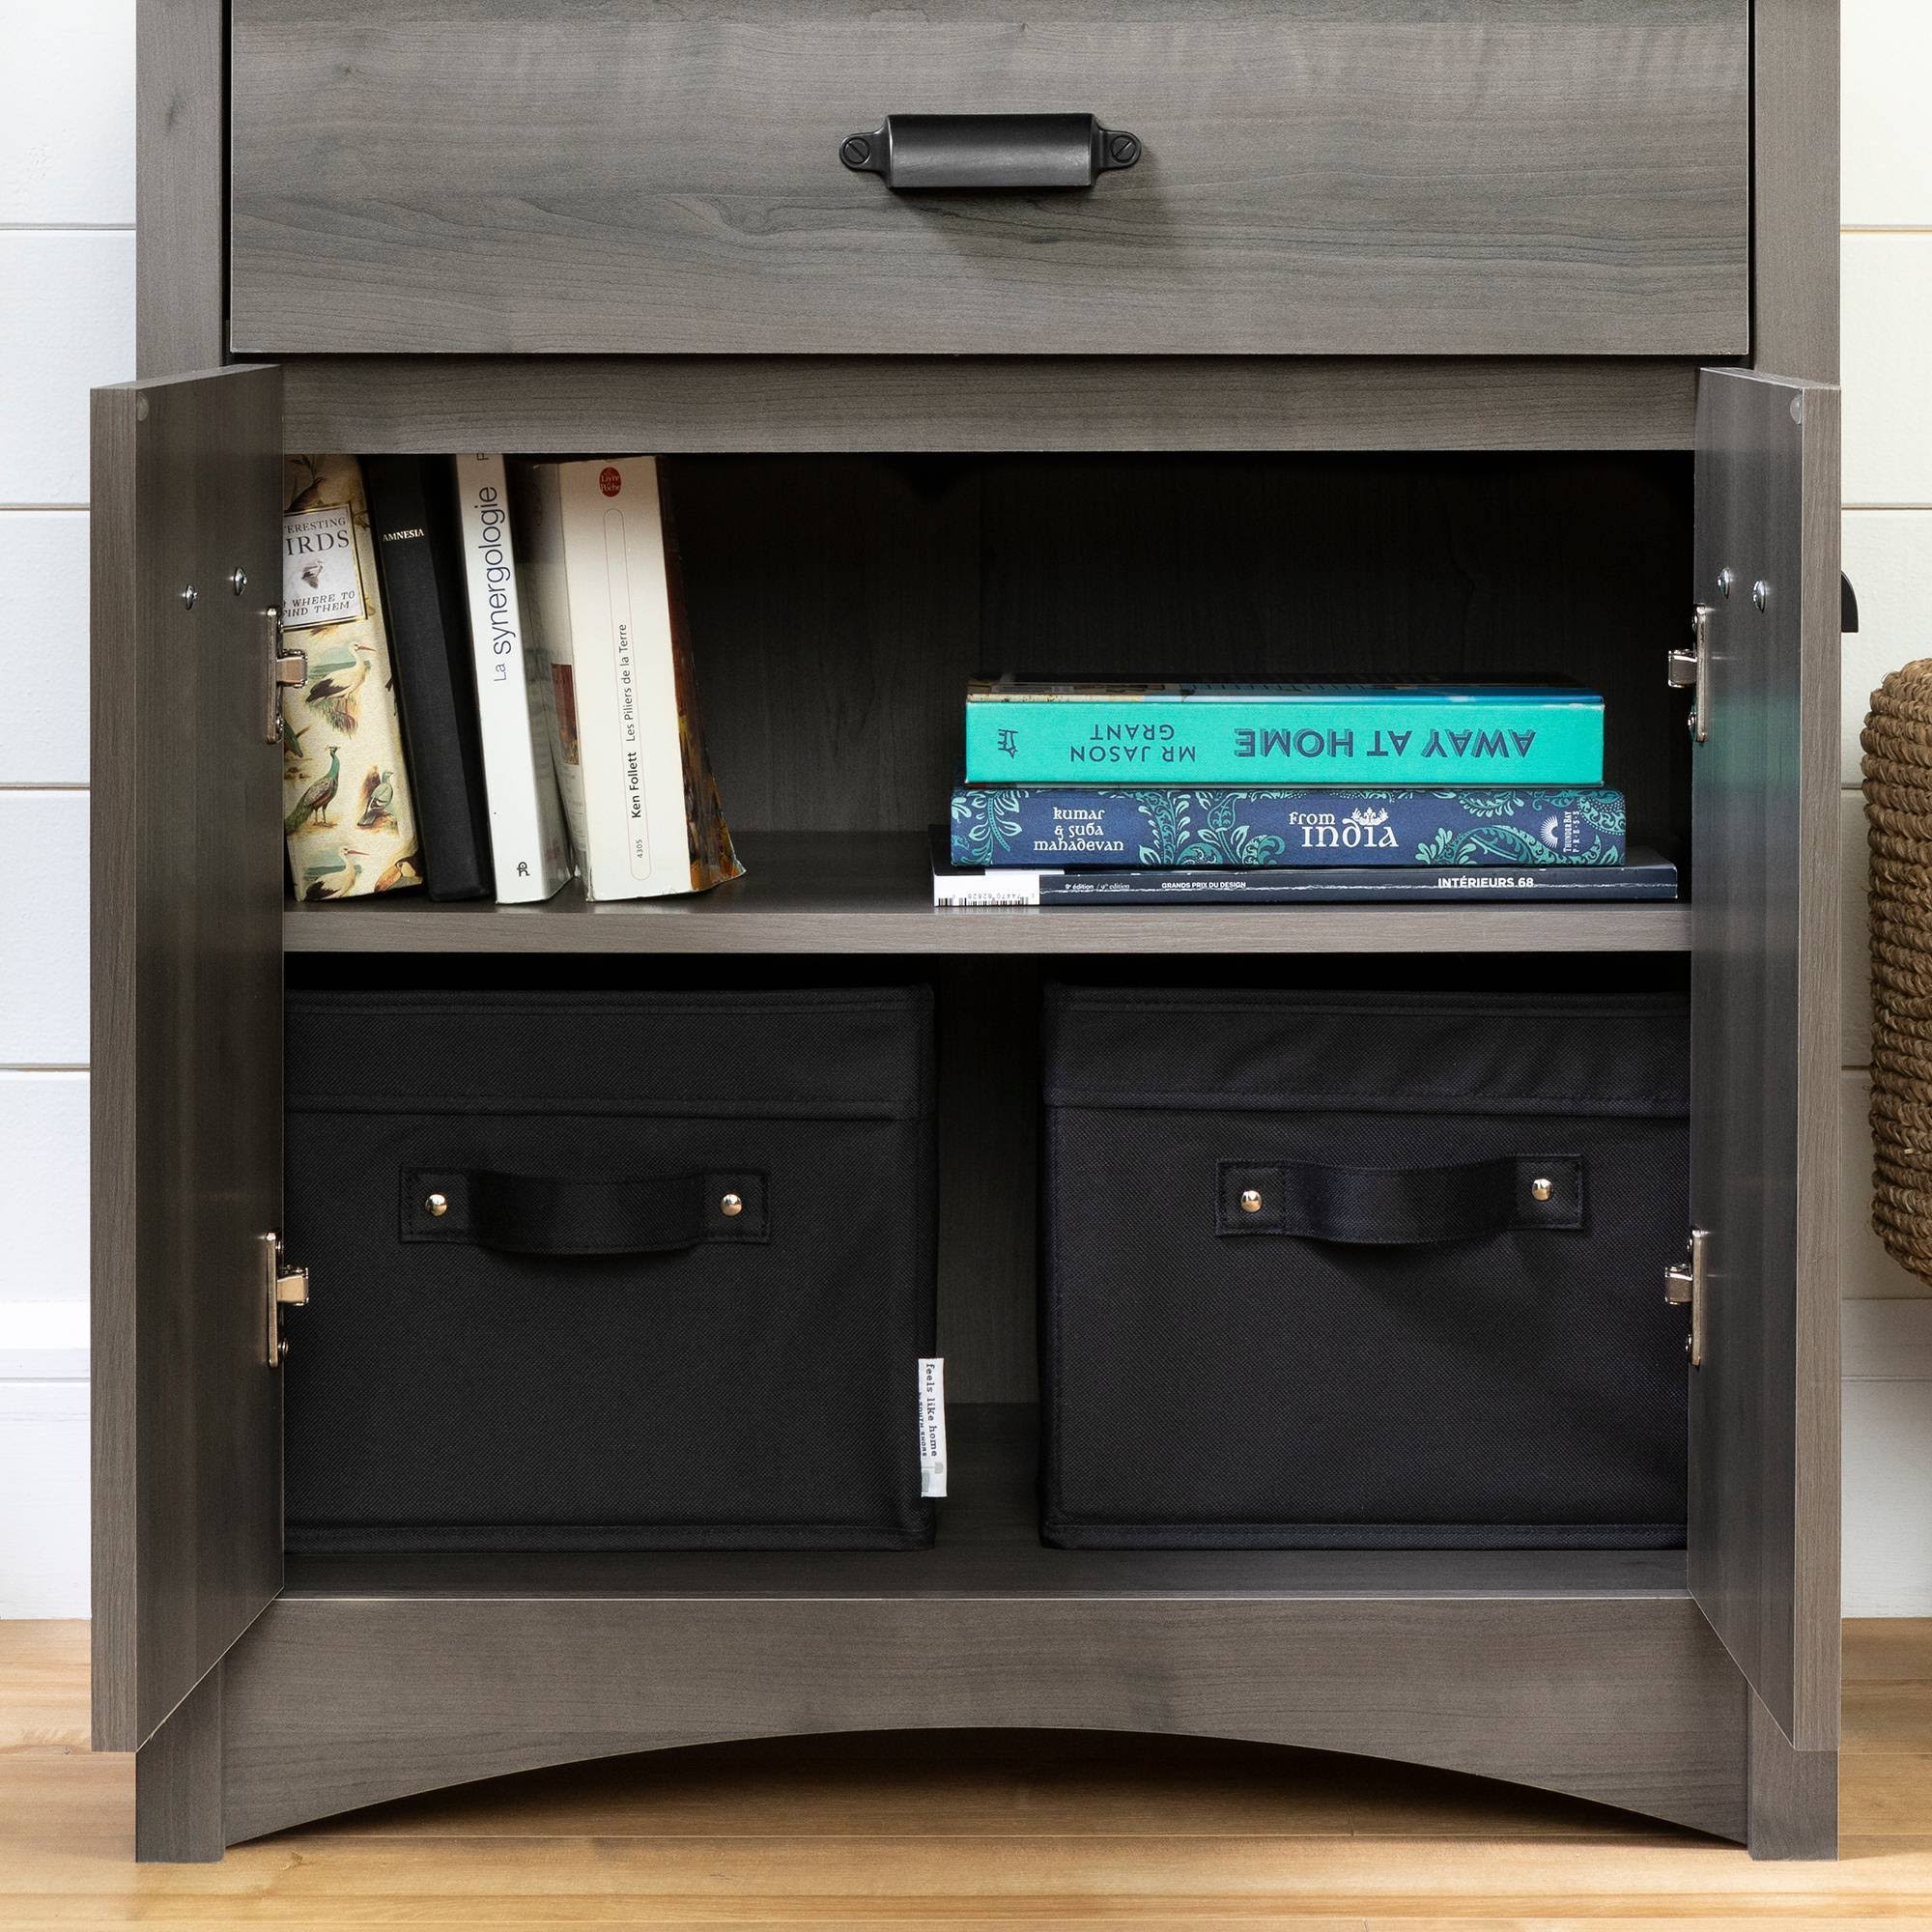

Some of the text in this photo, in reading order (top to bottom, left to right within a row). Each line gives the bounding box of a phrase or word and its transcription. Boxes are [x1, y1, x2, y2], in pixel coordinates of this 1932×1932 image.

[283, 517, 346, 534] ERESTING
[383, 528, 425, 542] AMNESIA
[474, 486, 516, 656] synergologie
[292, 593, 335, 608] WHERE
[341, 590, 355, 601] TO
[314, 601, 350, 613] THEM
[494, 663, 507, 682] La
[618, 624, 641, 818] Ken Follett Les Piliers de la Terre
[1089, 724, 1175, 741] GRANT
[1234, 727, 1537, 758] AWAY AT HOME
[1069, 746, 1197, 762] MR JASON
[1053, 807, 1105, 820] kumar
[1289, 811, 1337, 826] from
[1437, 875, 1534, 889] INTÉRIEURS 68
[925, 1363, 937, 1457] feels like home
